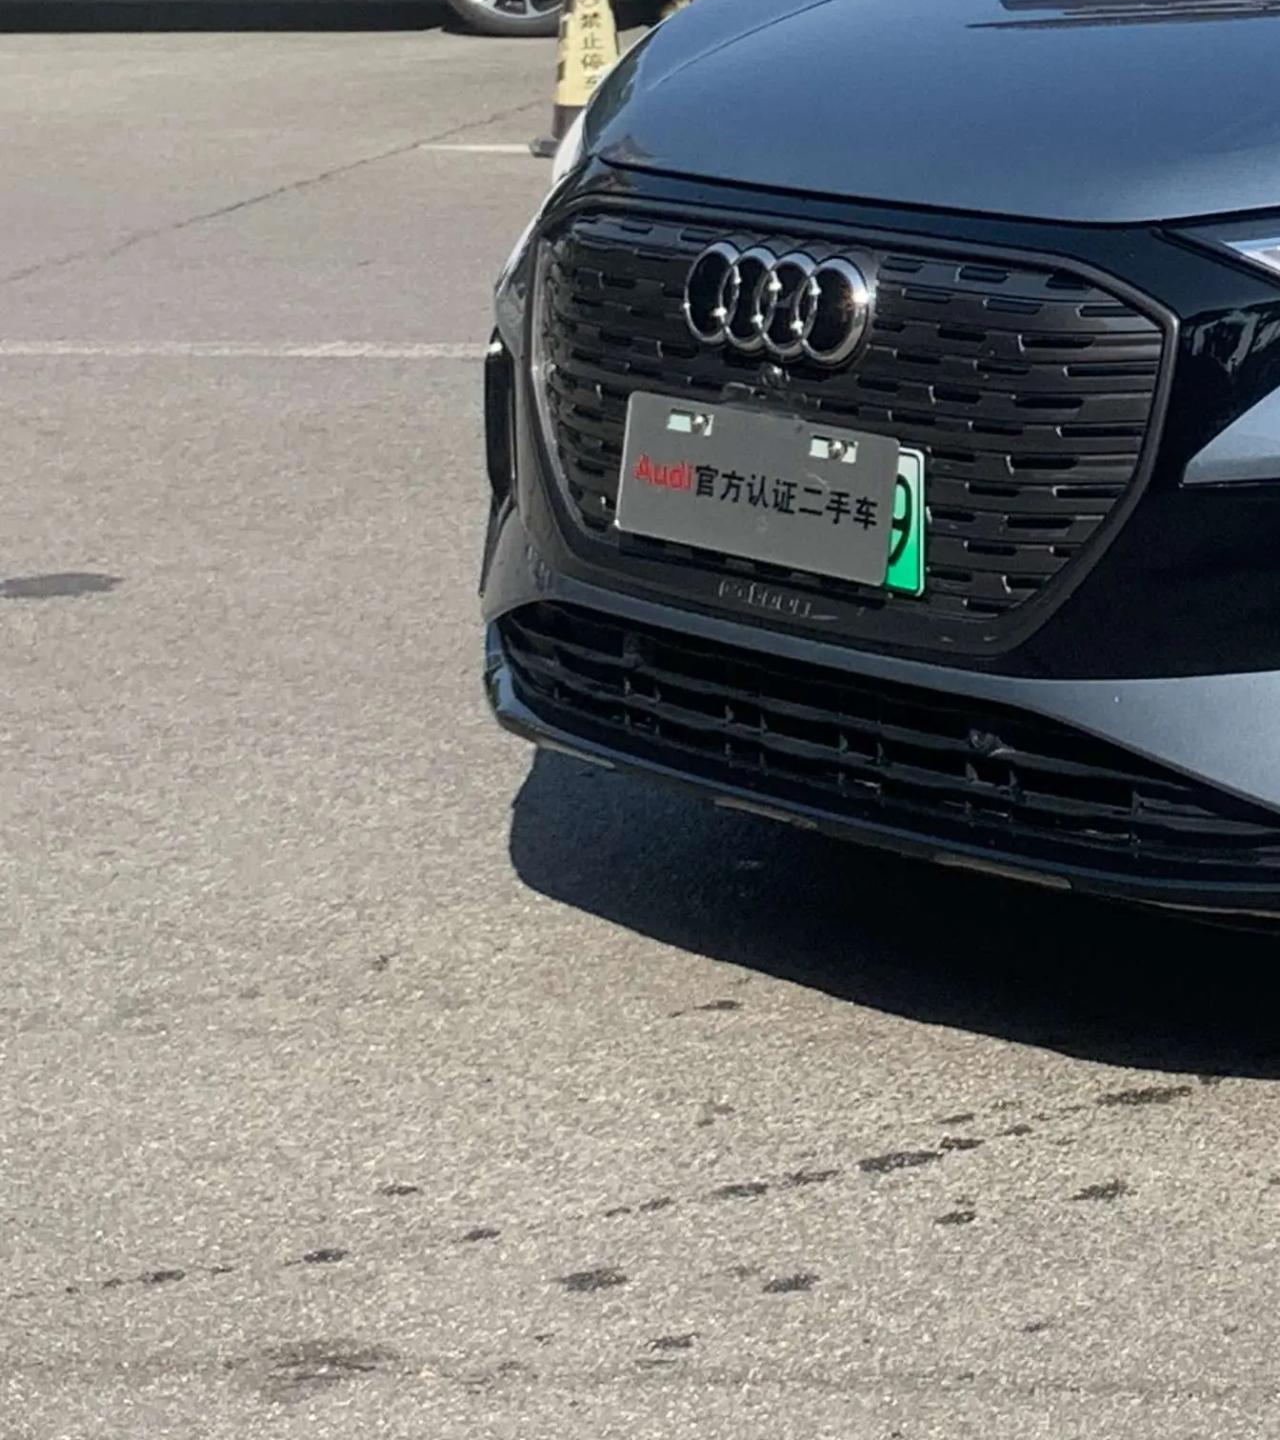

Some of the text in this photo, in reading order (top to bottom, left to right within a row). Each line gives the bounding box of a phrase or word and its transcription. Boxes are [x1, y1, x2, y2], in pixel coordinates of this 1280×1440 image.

[633, 454, 878, 531] Audi 官方认证二手车
